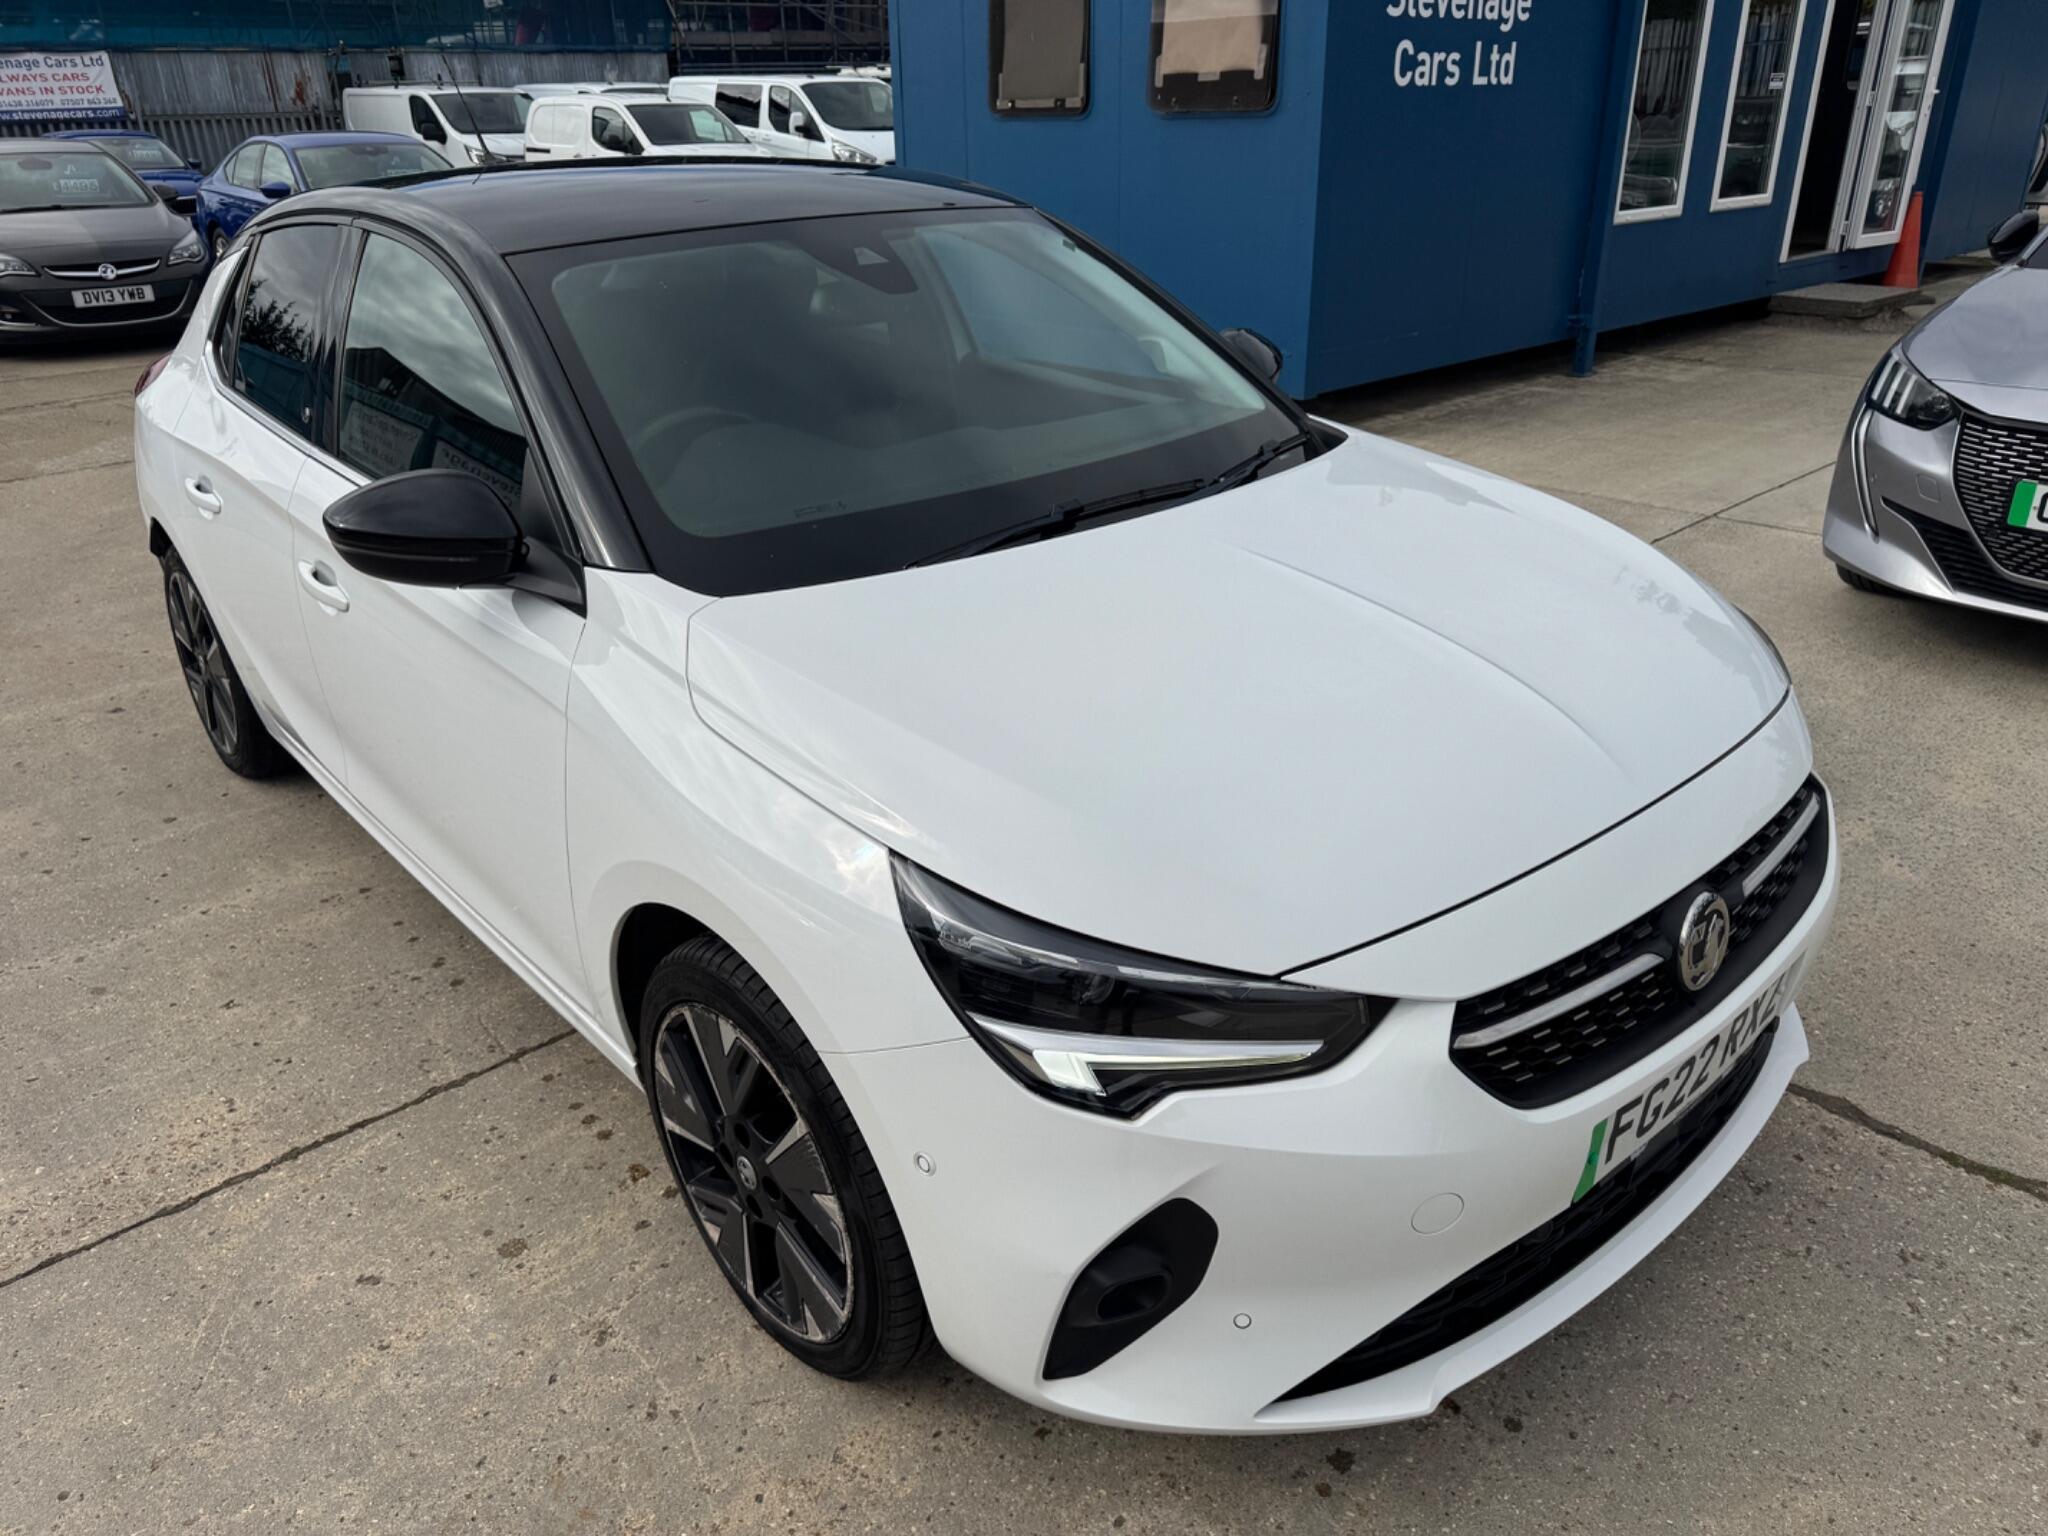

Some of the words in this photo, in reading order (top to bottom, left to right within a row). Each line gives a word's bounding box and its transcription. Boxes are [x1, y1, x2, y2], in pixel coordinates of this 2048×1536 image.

[43, 56, 77, 68] Cars
[81, 55, 104, 68] Ltd
[1393, 39, 1461, 87] Cars
[1472, 40, 1517, 86] Ltd
[52, 72, 90, 82] CARS
[40, 85, 55, 96] IN
[58, 84, 105, 95] STOCK
[0, 108, 120, 120] w.stevenagecars.com
[81, 289, 115, 304] DV13
[117, 287, 146, 301] YWB
[1605, 1034, 1720, 1165] FG22
[1719, 971, 1786, 1069] RXZ
